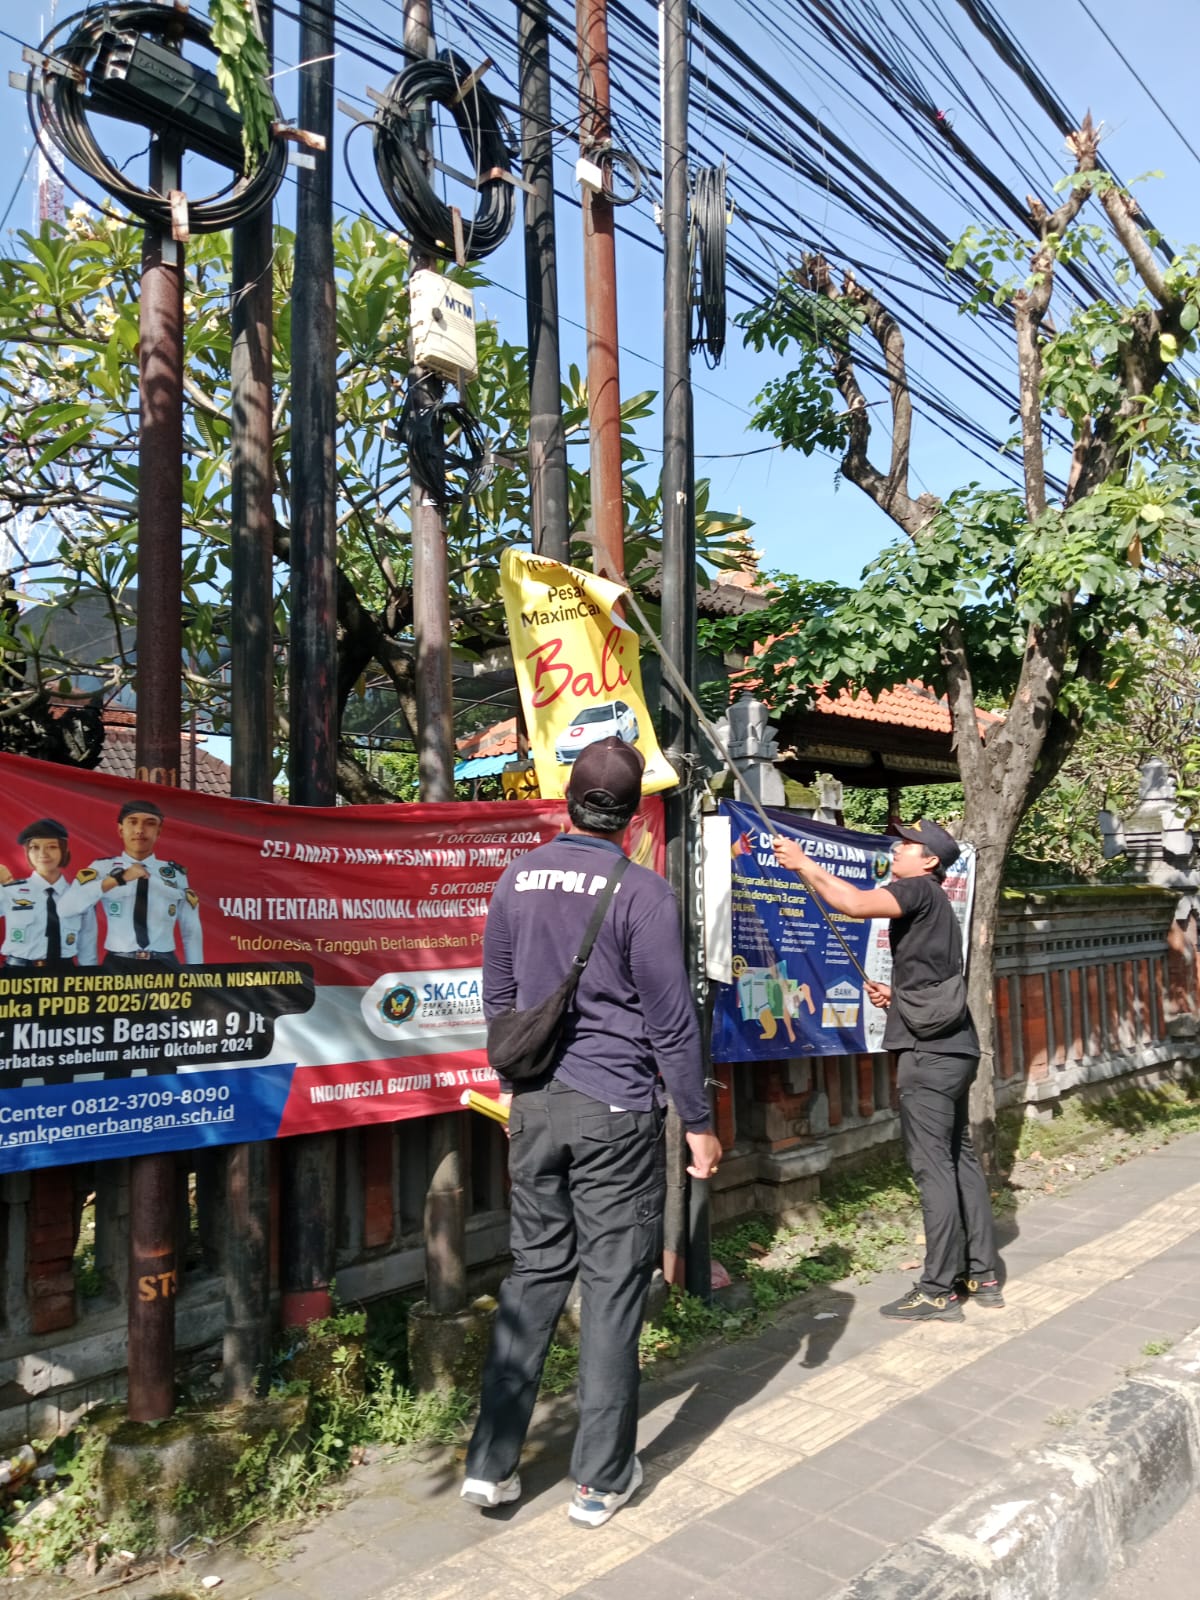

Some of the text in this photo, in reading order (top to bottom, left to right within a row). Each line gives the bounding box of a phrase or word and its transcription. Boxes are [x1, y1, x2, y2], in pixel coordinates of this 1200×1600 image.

[445, 295, 472, 319] MTM
[526, 625, 632, 708] Bali
[447, 833, 508, 844] OKTOBER
[510, 831, 541, 844] 2024
[260, 839, 339, 863] SELAMAT
[384, 848, 466, 867] KESAKTIAN
[514, 869, 587, 893] SATPOL
[837, 864, 868, 880] ANDA
[429, 883, 438, 895] 5
[266, 898, 339, 920] TENTARA
[342, 898, 415, 919] NASIONAL
[417, 897, 488, 919] INDONESIA
[315, 938, 377, 955] Tangguh
[380, 933, 467, 951] Berlandaskan
[0, 970, 303, 995] DUSTRI PENERBANGAN CAKRA NUSANTARA
[423, 980, 479, 1001] SKACA
[0, 991, 192, 1018] uka PPDB 2025/2026
[422, 1007, 481, 1017] CAKRA NUSA
[13, 1022, 105, 1050] Khusus
[113, 1015, 218, 1043] Beasiswa
[225, 1012, 240, 1035] 9
[245, 1011, 266, 1035] Jt
[0, 1037, 253, 1070] erbatas sebelum akhir Oktober 2024
[310, 1079, 384, 1104] INDONESIA
[387, 1073, 432, 1093] BUTUH
[434, 1071, 455, 1087] 130
[1, 1086, 230, 1123] Center 0812-3709-8090
